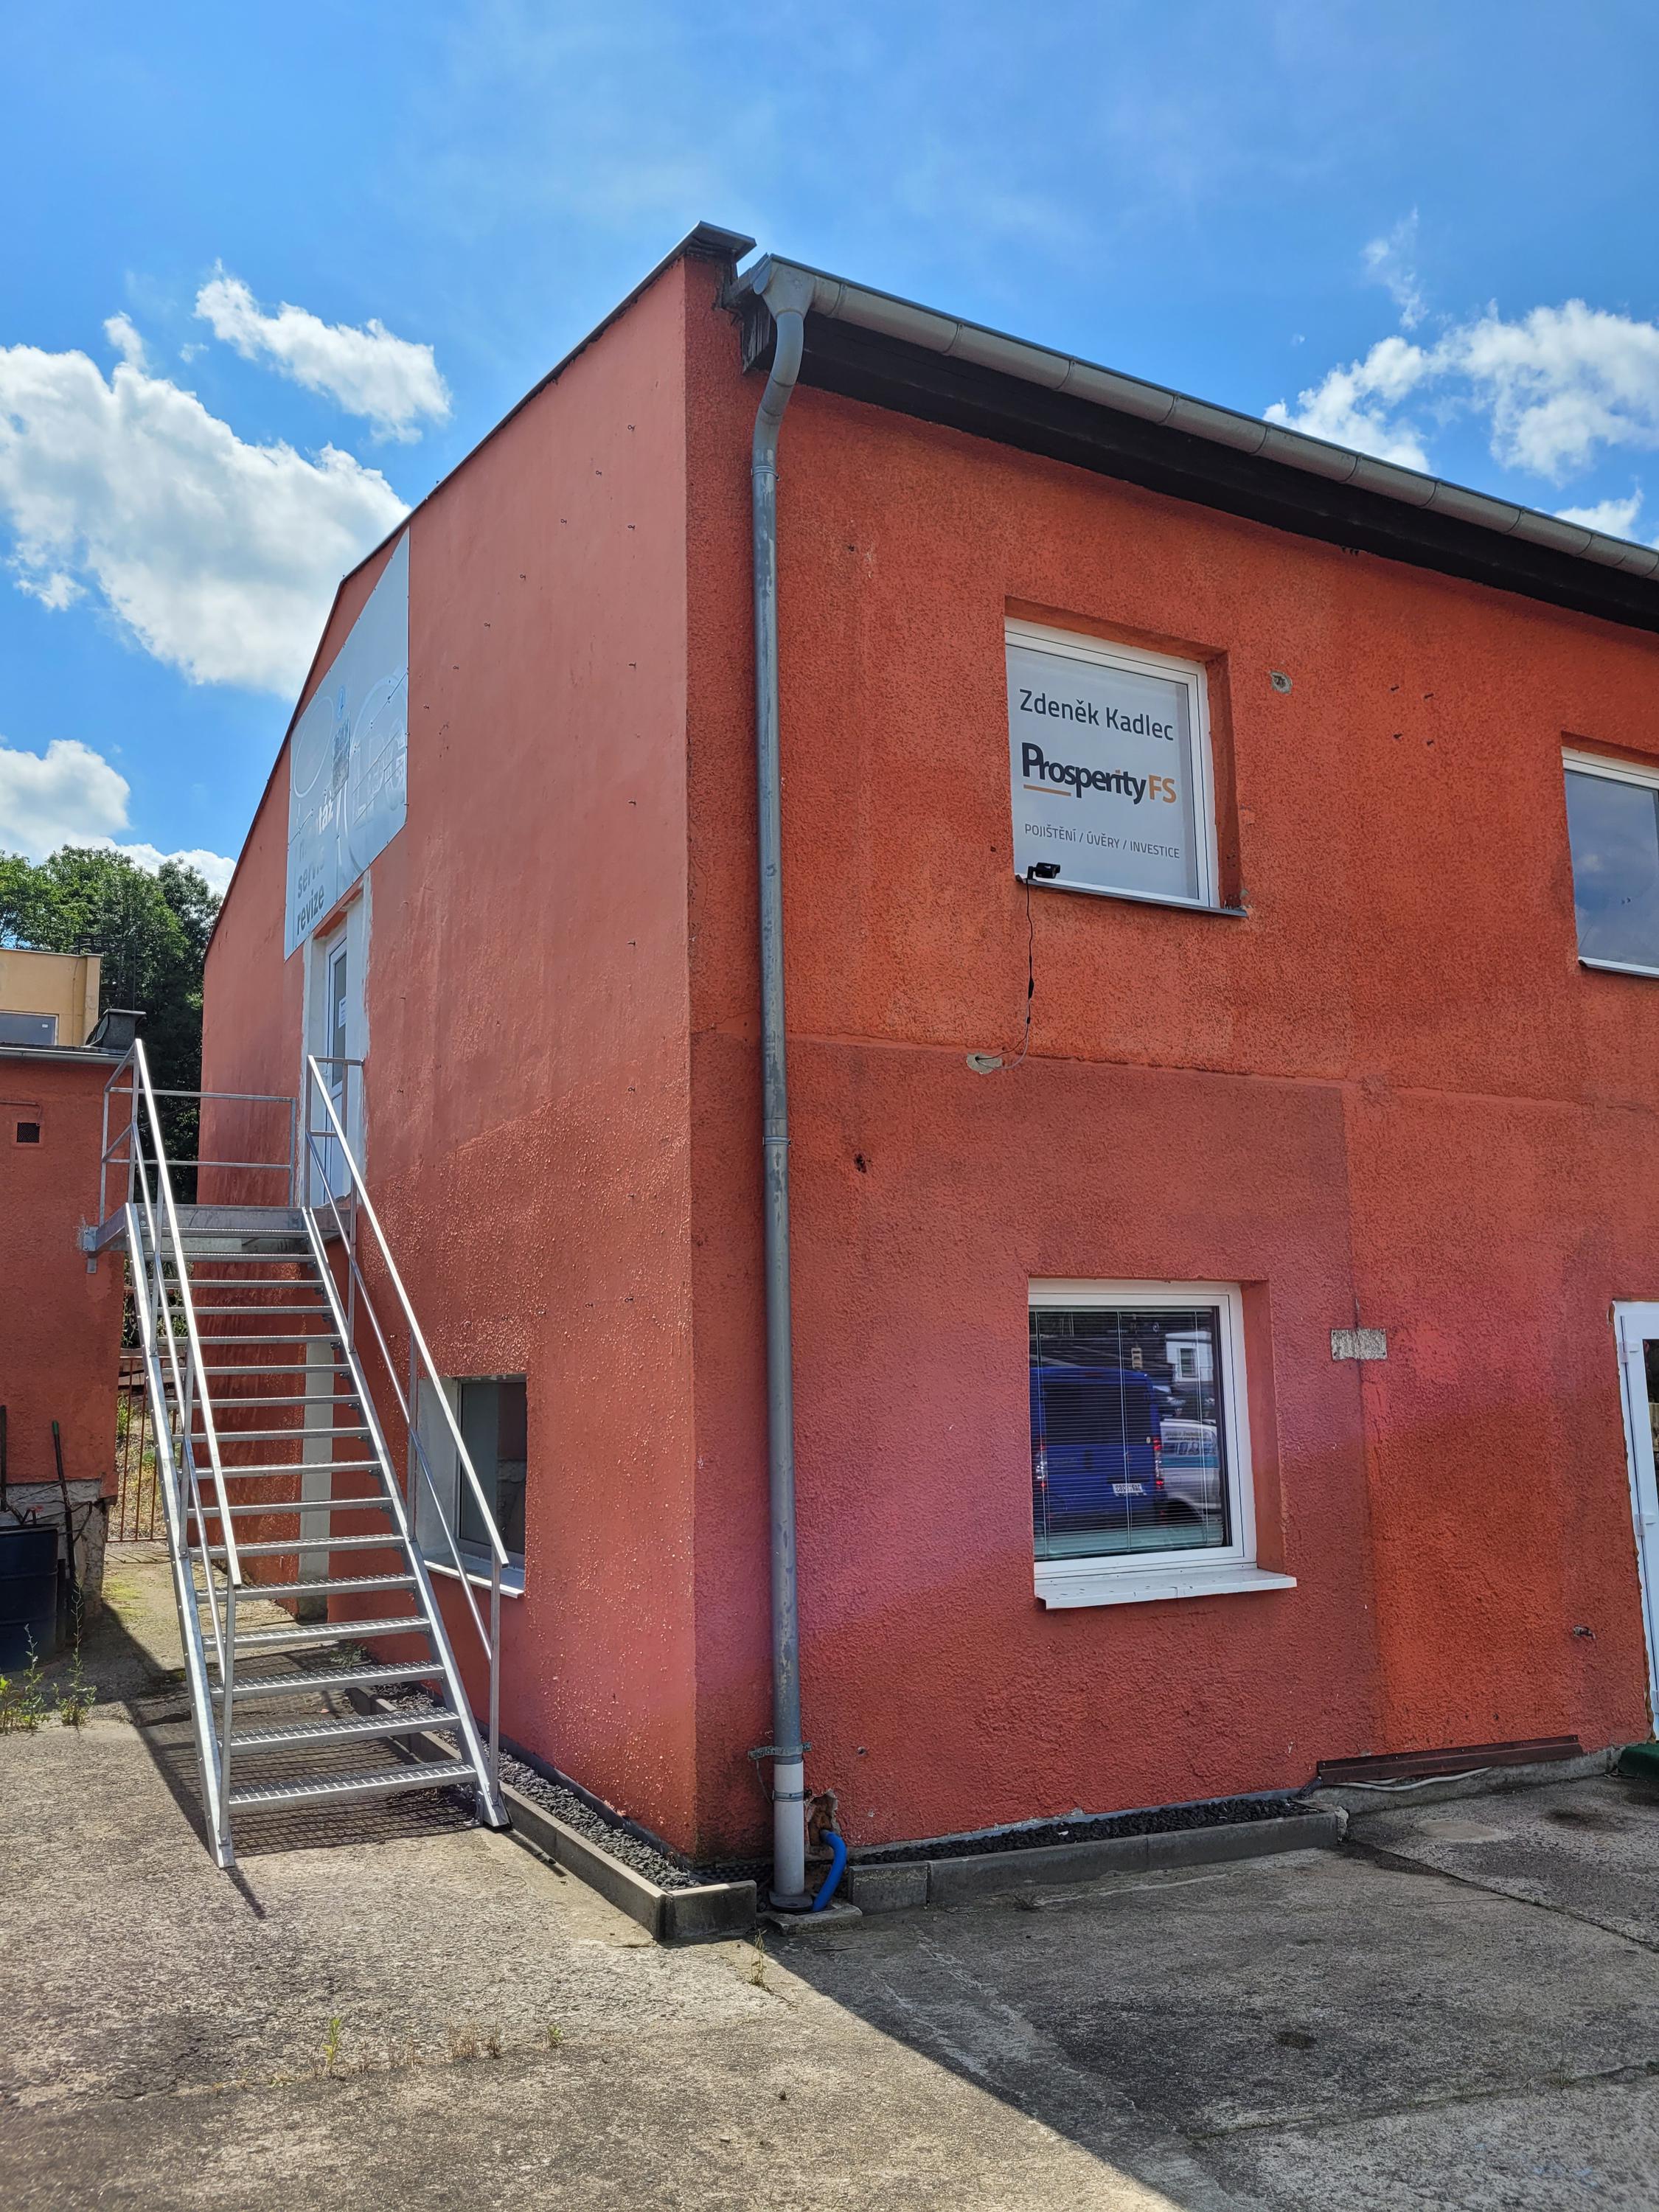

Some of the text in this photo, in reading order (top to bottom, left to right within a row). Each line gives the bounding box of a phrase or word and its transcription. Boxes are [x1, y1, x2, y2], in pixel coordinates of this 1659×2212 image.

[1020, 689, 1174, 740] Zdeněk Kadlec
[1025, 824, 1077, 842] POJIŠTĚNÍ
[1087, 831, 1120, 849] ÚVĚRY
[1130, 841, 1180, 859] INVESTICE
[297, 885, 324, 936] revize
